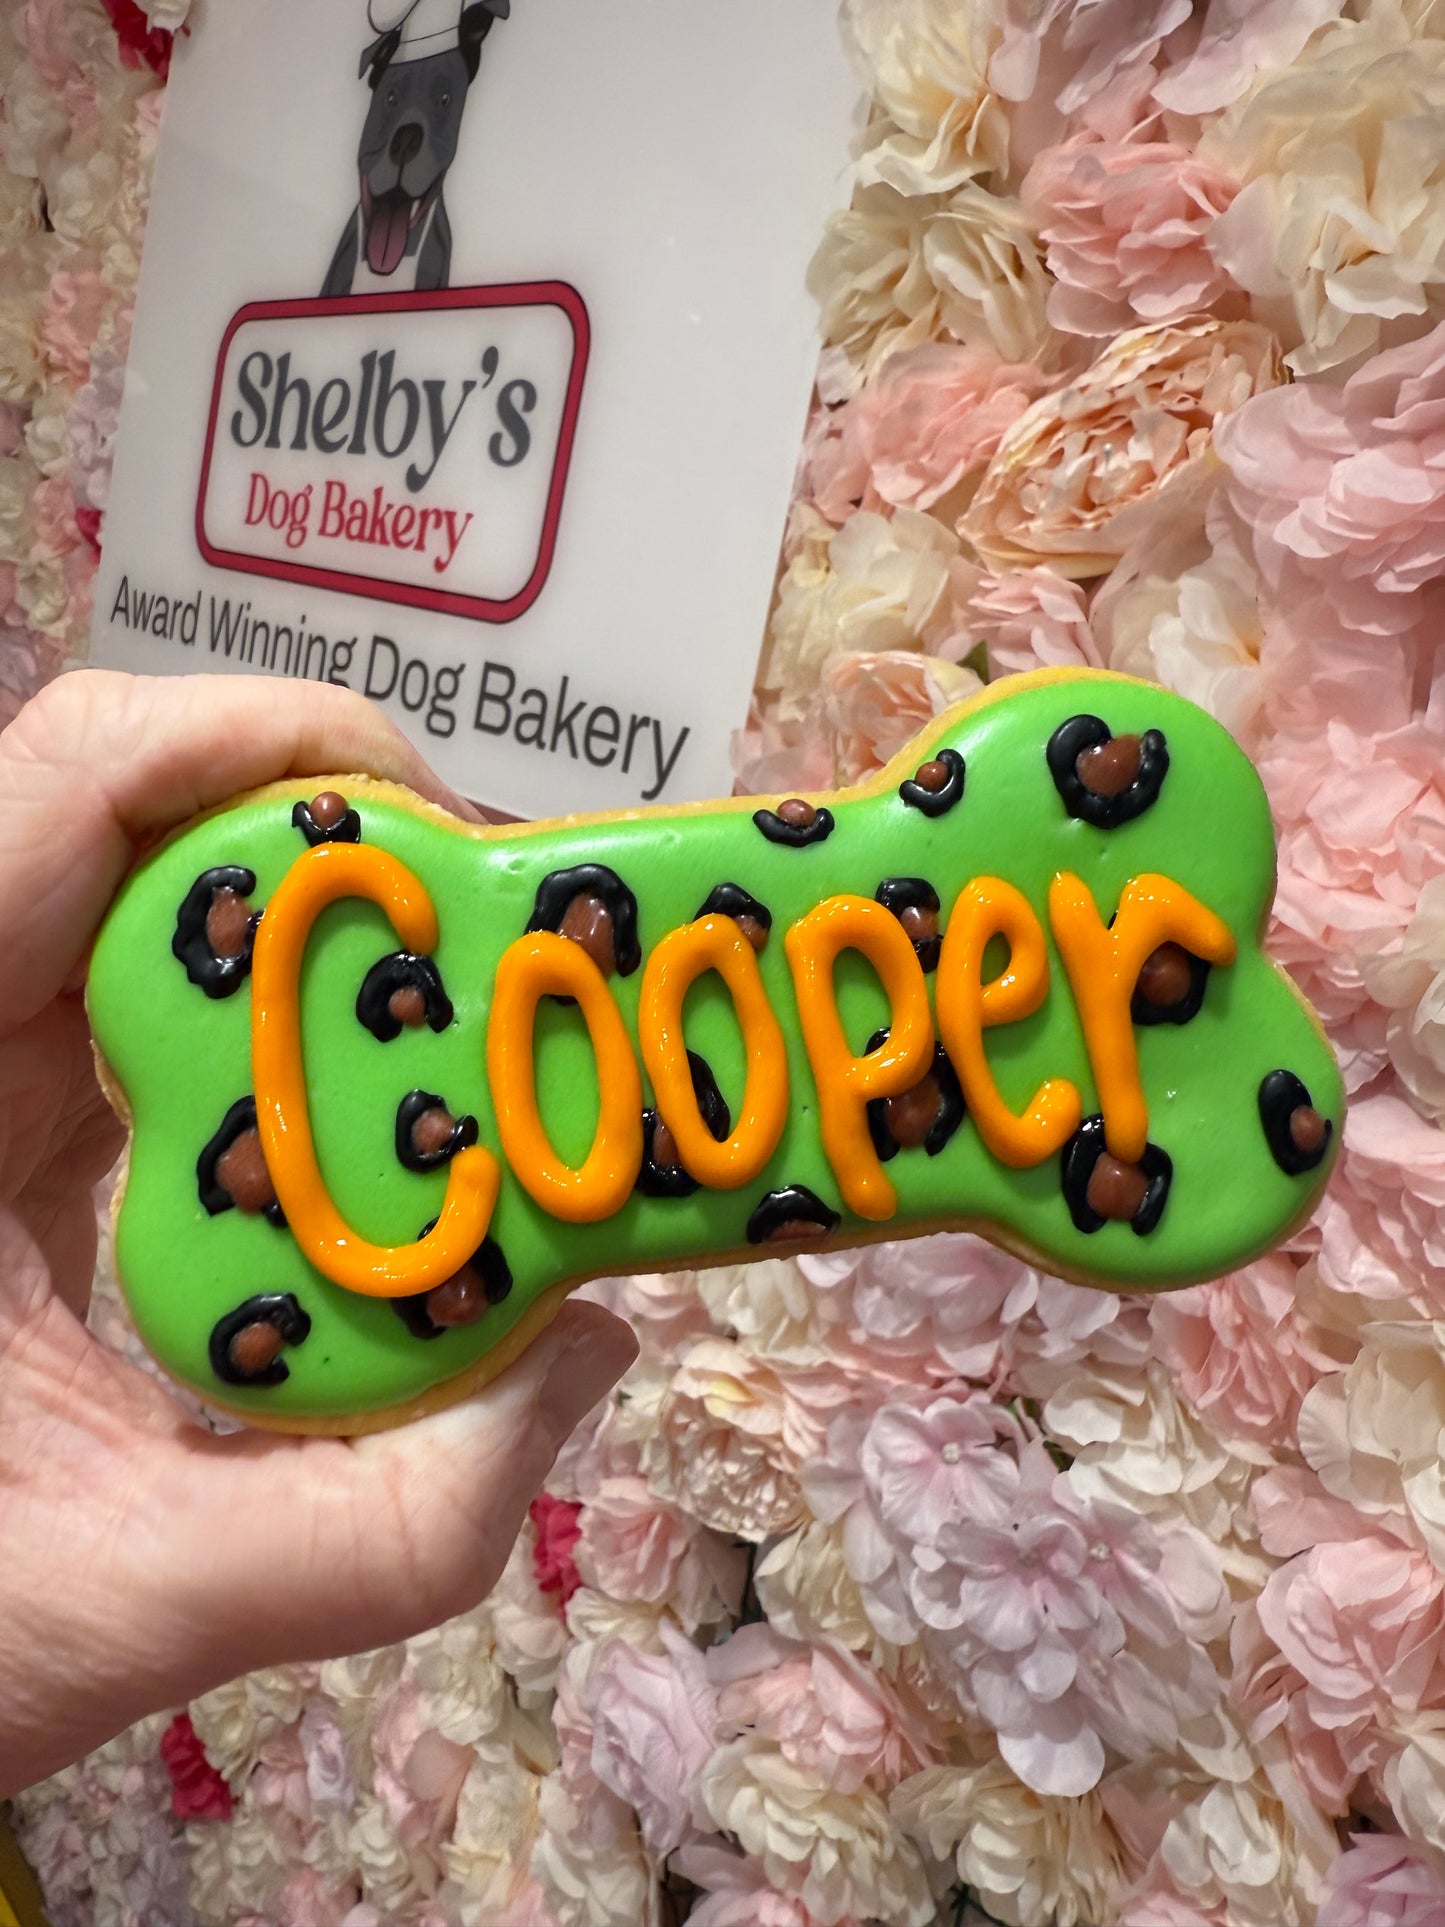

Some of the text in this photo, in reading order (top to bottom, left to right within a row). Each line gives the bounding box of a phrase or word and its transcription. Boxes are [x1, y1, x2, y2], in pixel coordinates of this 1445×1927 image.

[230, 345, 538, 493] Shelby's
[244, 472, 475, 573] Dog Bakery
[110, 575, 691, 801] Award Winning Dog Bakery
[251, 841, 1236, 1298] Cooper
